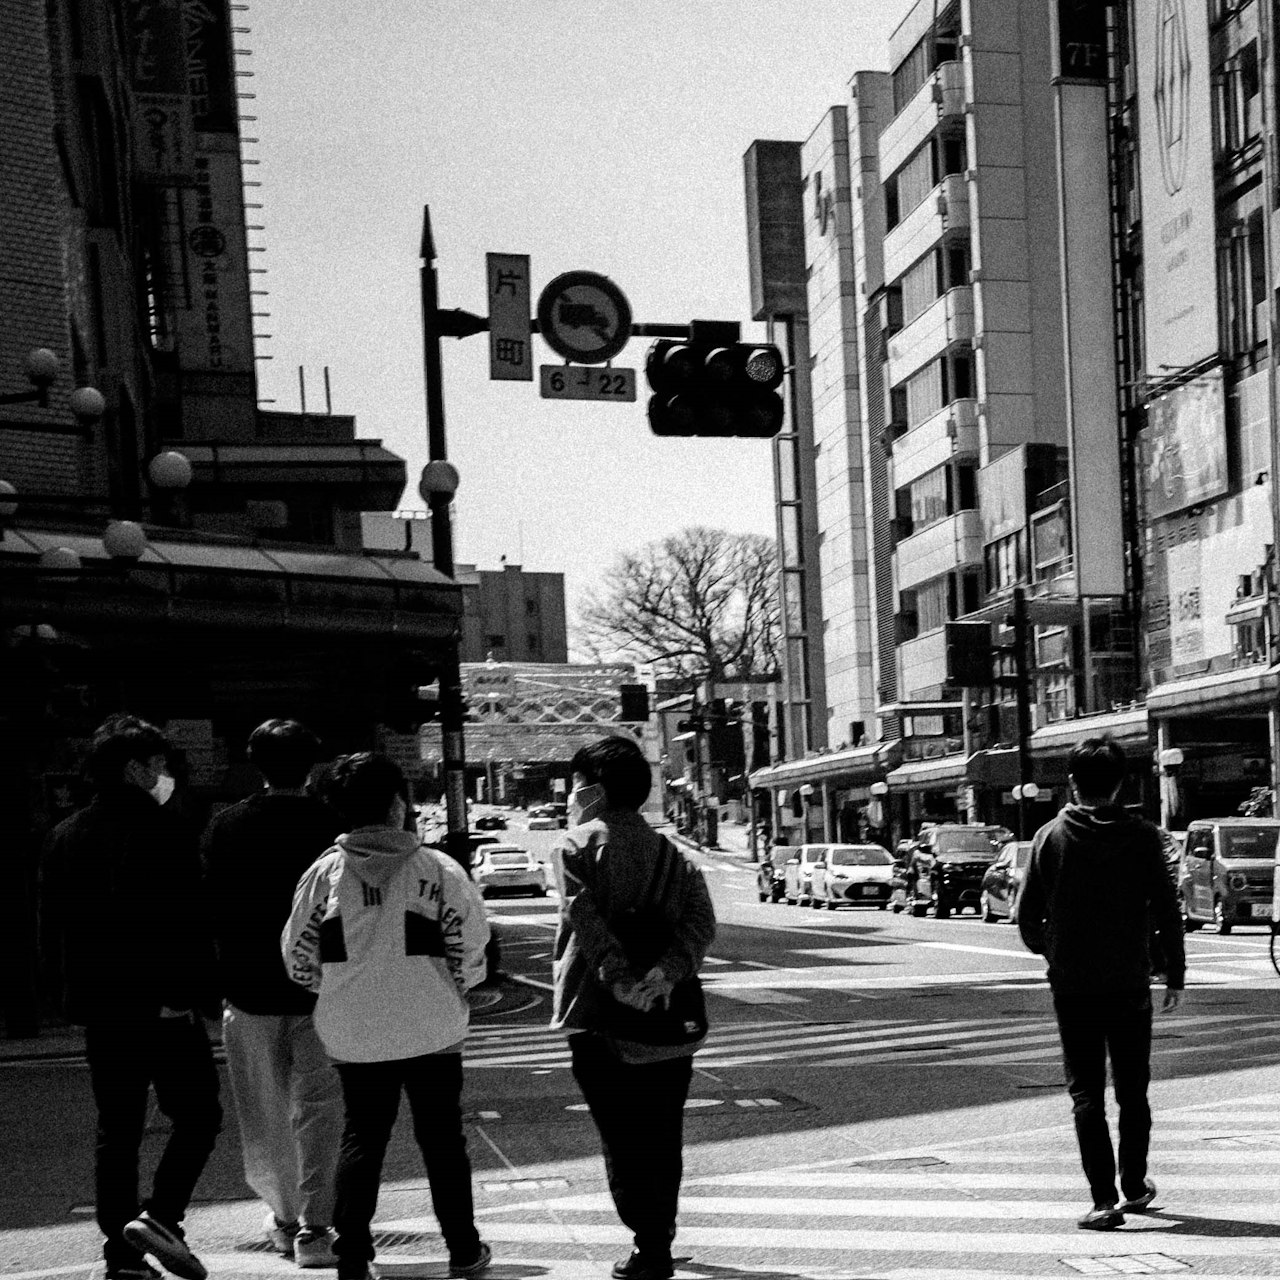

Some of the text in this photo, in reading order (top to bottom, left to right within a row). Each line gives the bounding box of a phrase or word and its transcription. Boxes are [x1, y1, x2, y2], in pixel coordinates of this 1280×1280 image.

[1065, 41, 1102, 67] 7F
[494, 268, 525, 366] 片町
[550, 371, 565, 392] 6
[599, 374, 627, 395] 22
